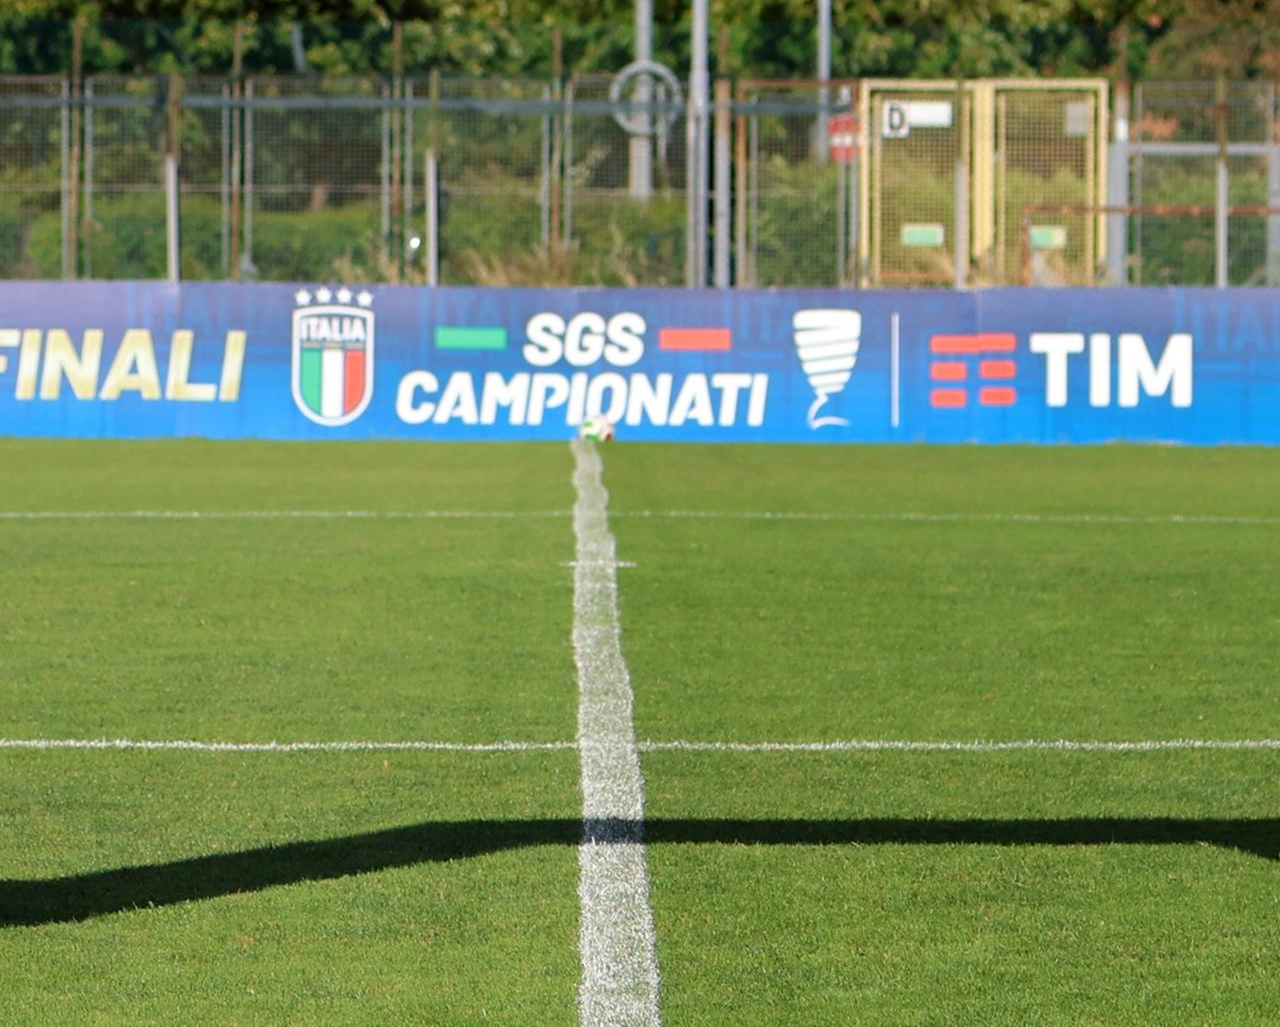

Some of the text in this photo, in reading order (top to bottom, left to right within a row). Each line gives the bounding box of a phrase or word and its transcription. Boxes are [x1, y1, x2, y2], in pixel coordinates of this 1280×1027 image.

[301, 317, 365, 341] ITALIA
[523, 311, 647, 367] SGS
[1029, 332, 1194, 408] TIM
[394, 370, 770, 427] CAMPIONATI
